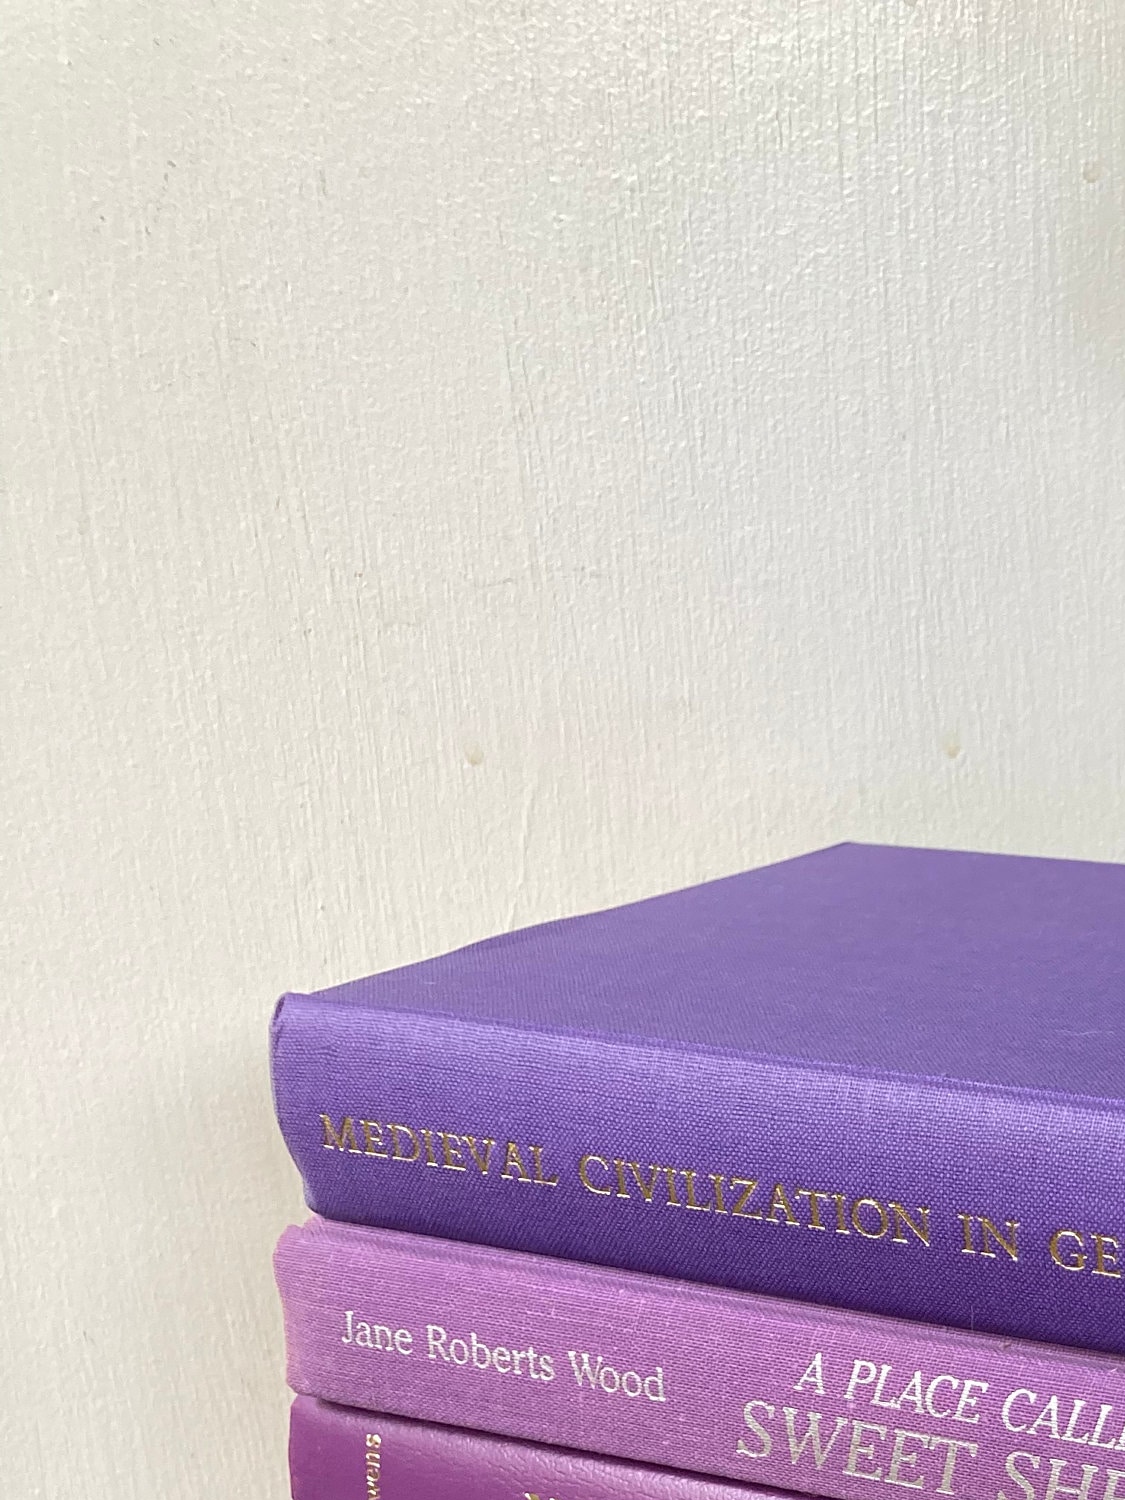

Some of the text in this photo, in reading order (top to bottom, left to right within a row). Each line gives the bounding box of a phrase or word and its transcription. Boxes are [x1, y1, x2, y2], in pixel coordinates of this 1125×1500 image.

[318, 1112, 558, 1187] MEDIEVAL
[577, 1153, 932, 1247] CIVILIZATION
[957, 1212, 1020, 1262] IN
[341, 1310, 667, 1403] Jane Roberts Wood
[794, 1352, 827, 1396] A
[843, 1359, 989, 1425] PLACE
[735, 1399, 978, 1497] SWEET
